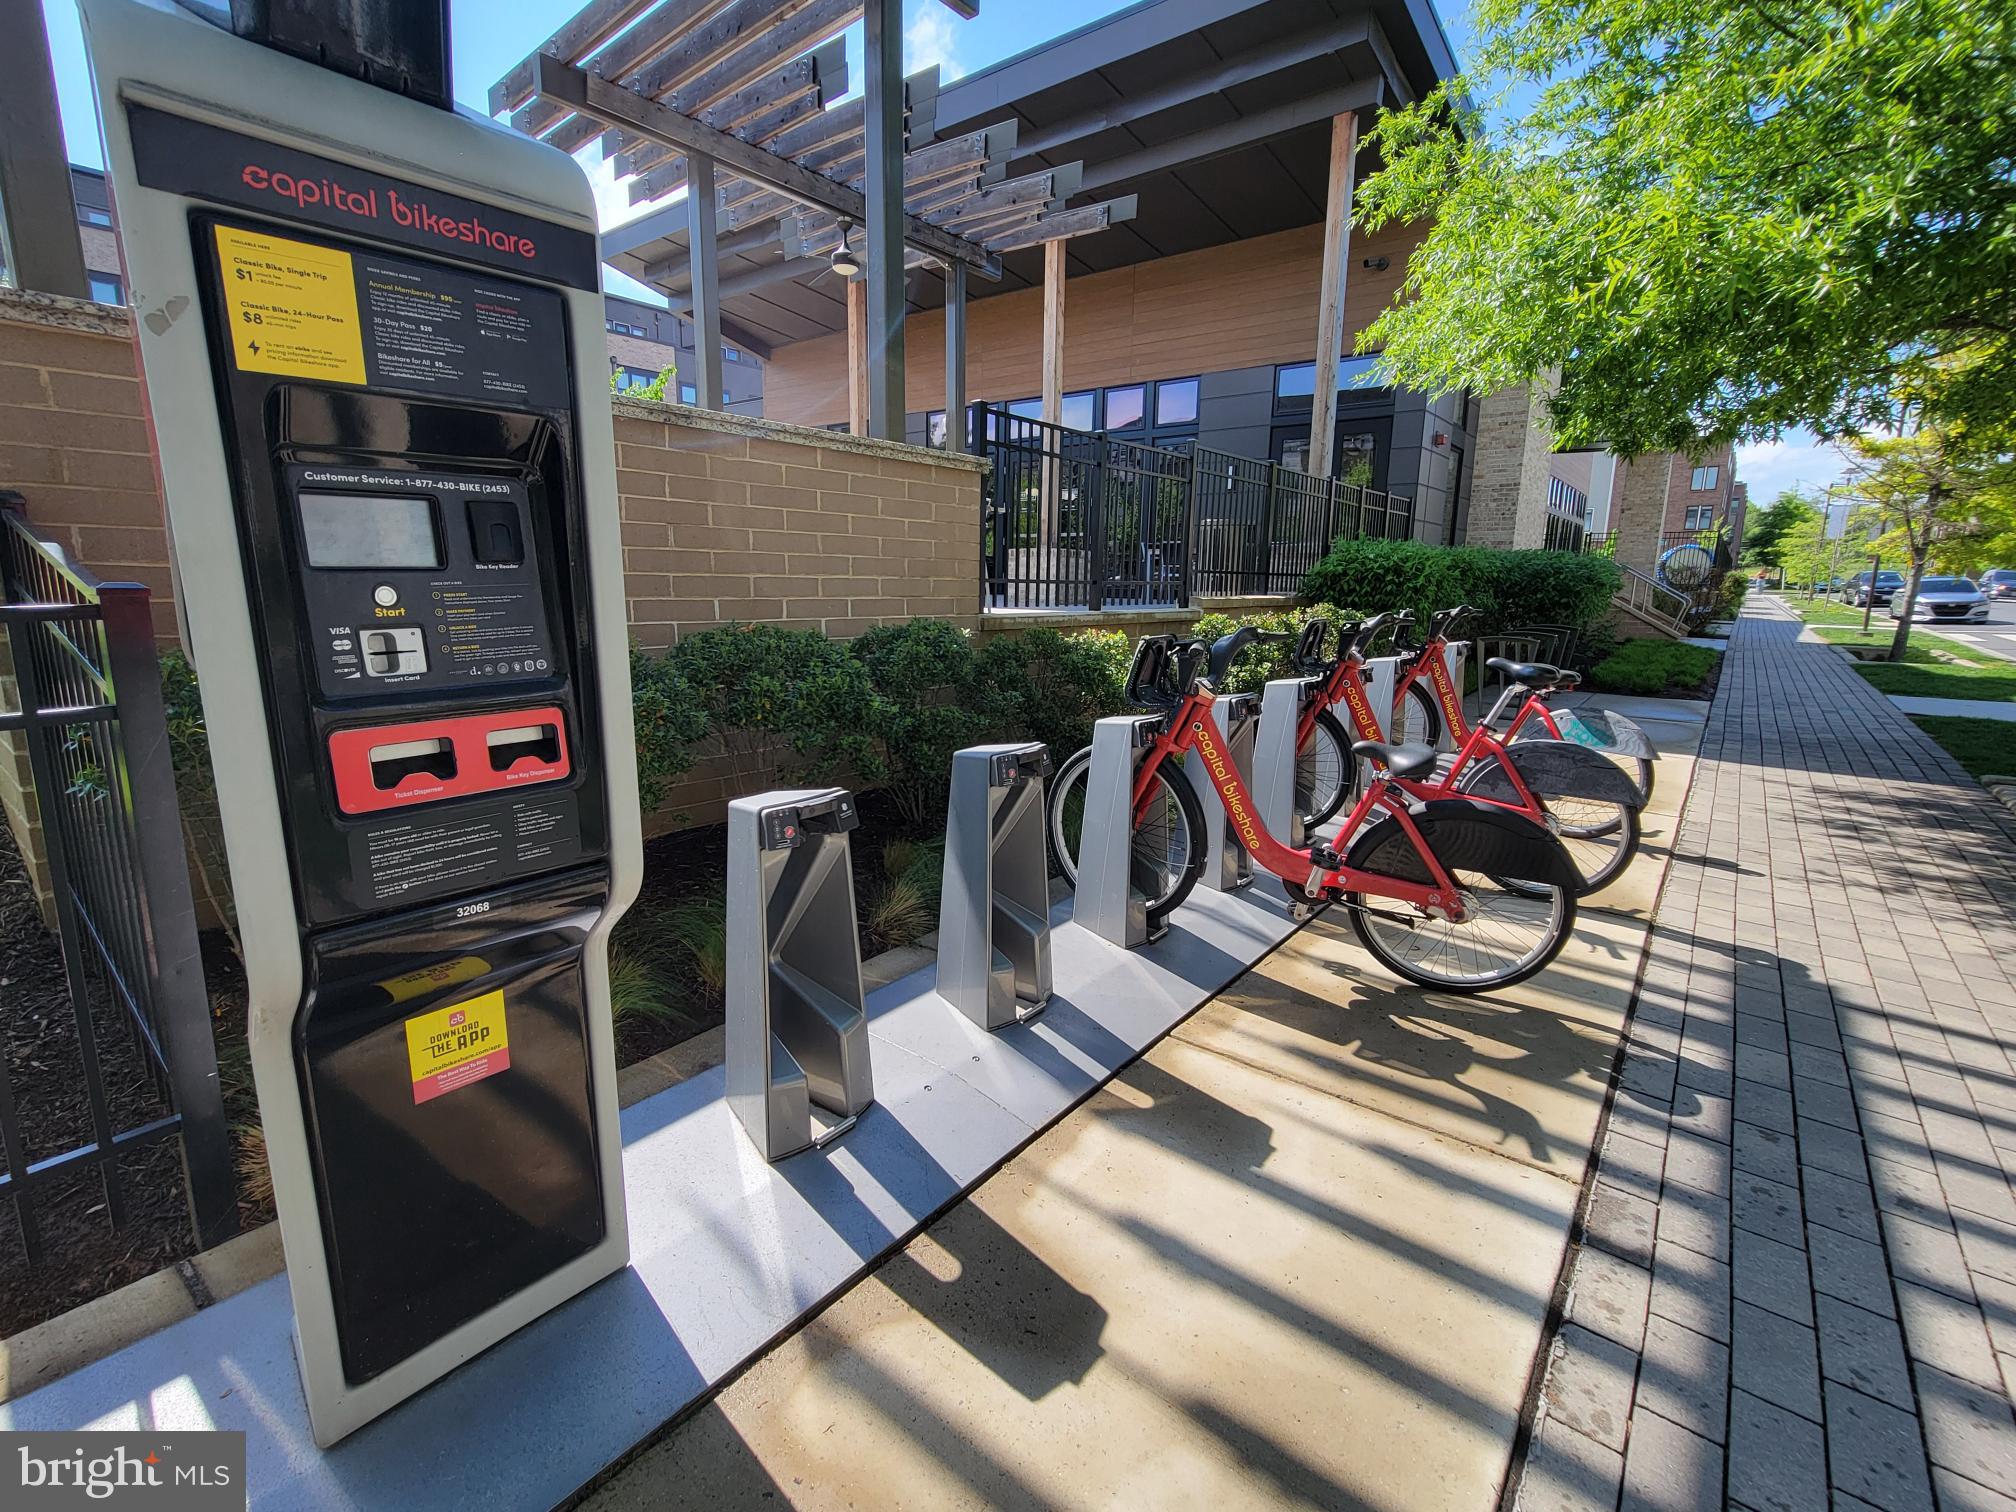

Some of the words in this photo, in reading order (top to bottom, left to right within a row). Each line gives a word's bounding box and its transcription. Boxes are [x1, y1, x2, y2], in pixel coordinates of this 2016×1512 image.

[241, 165, 377, 218] capital
[389, 190, 537, 259] bikeshare
[233, 257, 264, 269] Classic
[265, 262, 285, 273] Bike,
[287, 267, 311, 278] Single
[312, 271, 328, 281] Trip
[235, 267, 253, 282] $1
[368, 280, 394, 291] Annual
[394, 285, 436, 300] Membership
[240, 300, 270, 311] Classic
[271, 305, 292, 316] Bike,
[292, 309, 325, 320] 24-Hour
[326, 314, 344, 324] Pass
[242, 311, 263, 325] $8
[374, 317, 398, 328] 30-Day
[400, 322, 416, 330] Pass
[420, 324, 432, 332] $20
[378, 353, 410, 364] Bikeshare
[304, 471, 358, 483] Customer
[361, 474, 404, 486] Service:
[405, 478, 481, 492] 1-877-430-BIKE
[482, 483, 510, 494] (2453)
[374, 606, 406, 618] Start
[328, 627, 351, 636] VISA
[384, 676, 402, 684] Insert
[403, 674, 420, 682] Card
[1348, 687, 1372, 726] capital
[1433, 662, 1450, 694] capital
[1444, 693, 1462, 737] bikeshare
[519, 772, 529, 780] Key
[529, 768, 556, 777] Dispenser
[394, 791, 412, 799] Ticket
[413, 786, 444, 796] Dispenser
[1198, 732, 1232, 780] capital
[1223, 781, 1260, 850] bikeshare
[456, 902, 490, 918] 32068
[423, 1040, 455, 1058] THE
[457, 1026, 491, 1051] APP
[430, 1021, 480, 1044] DOWNLOAD
[422, 1043, 502, 1076] capitalbikeshare.com/app
